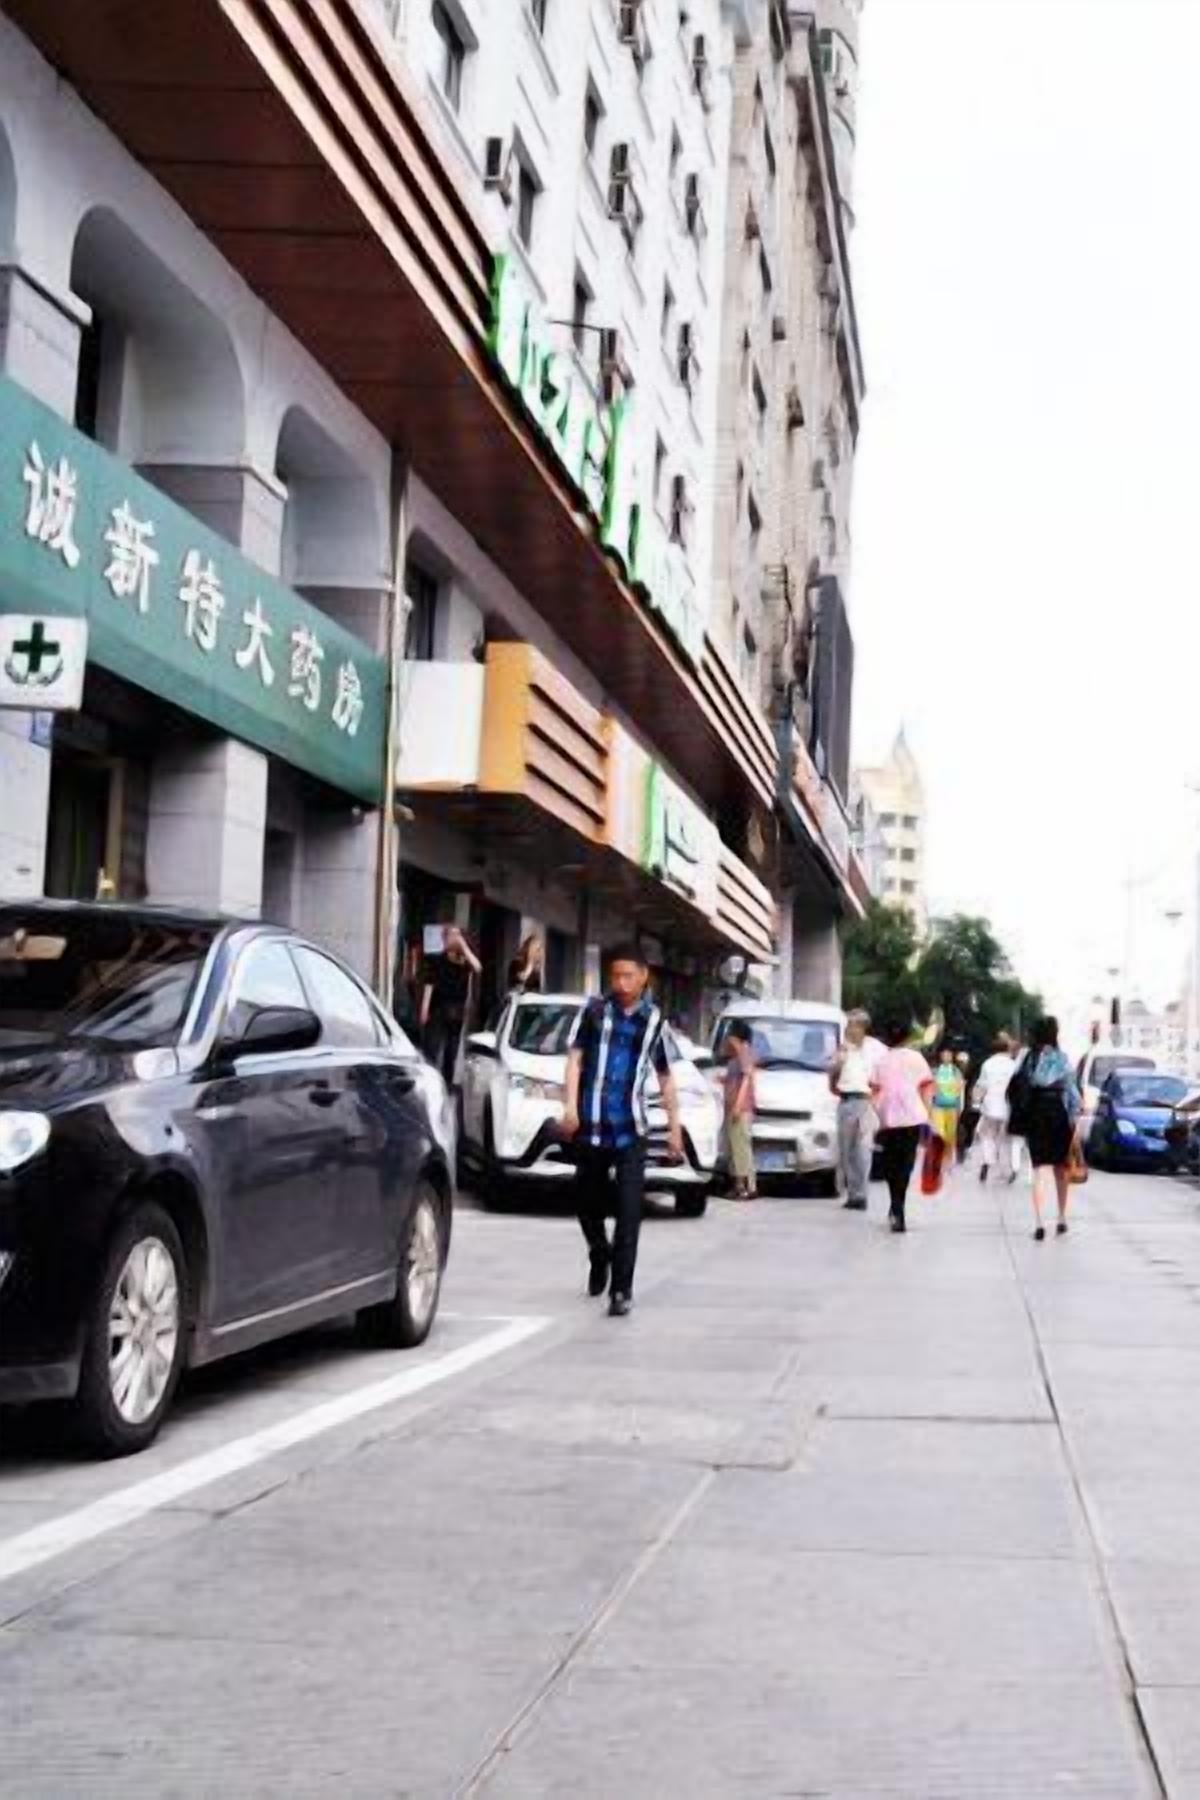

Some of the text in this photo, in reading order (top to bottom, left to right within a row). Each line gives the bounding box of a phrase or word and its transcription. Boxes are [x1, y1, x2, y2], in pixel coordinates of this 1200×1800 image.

[23, 441, 363, 736] 诚新特大药房
